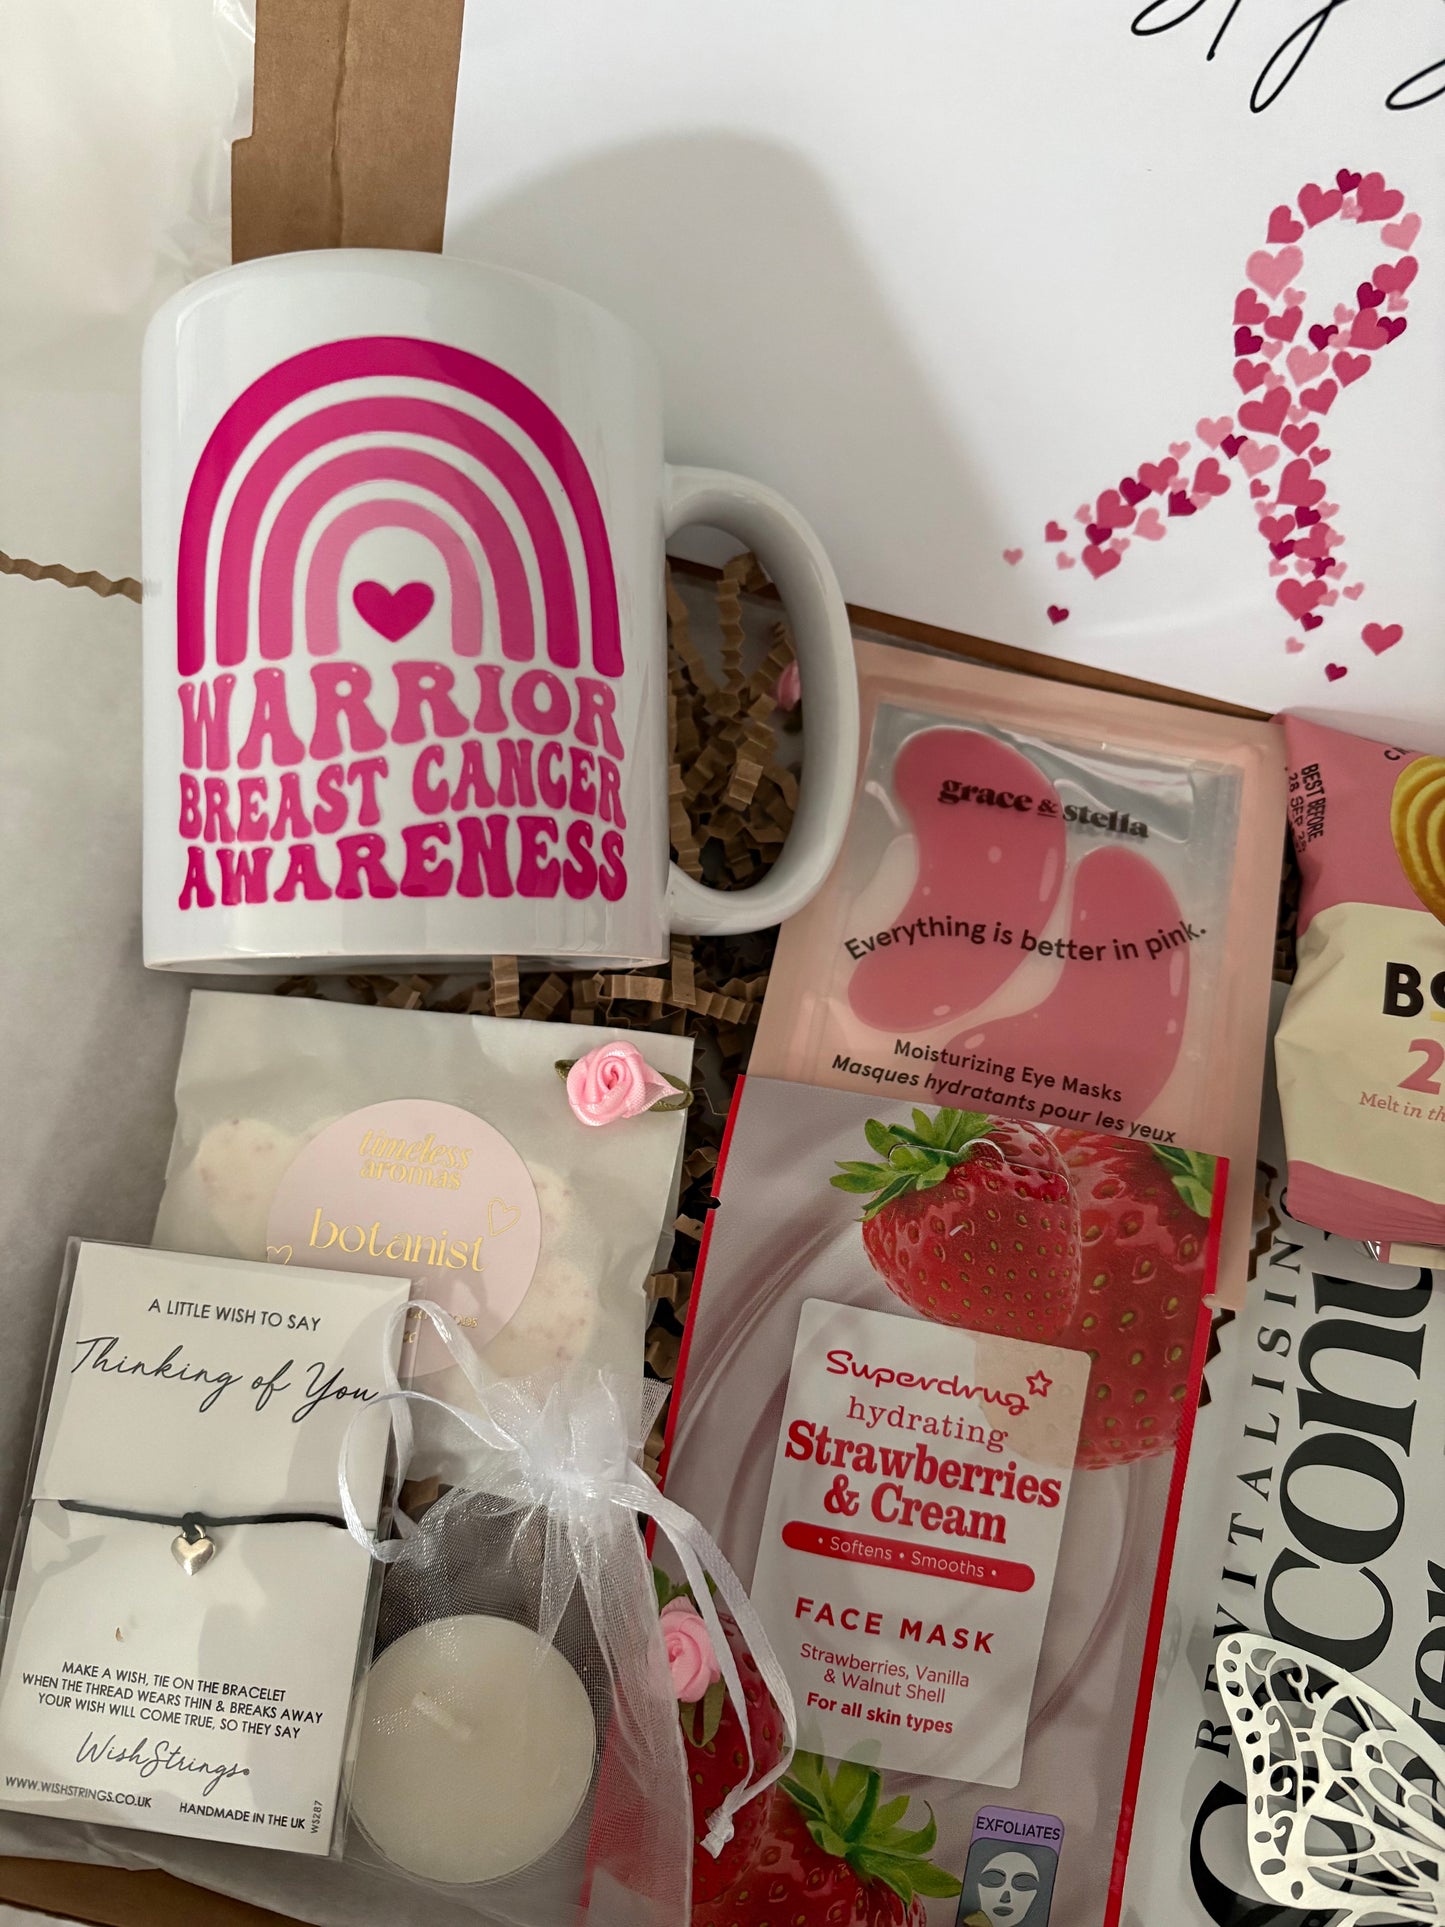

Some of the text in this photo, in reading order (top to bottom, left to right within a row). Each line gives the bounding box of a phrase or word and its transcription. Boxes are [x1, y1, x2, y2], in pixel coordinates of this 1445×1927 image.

[178, 661, 624, 772] WARRIOR
[179, 738, 627, 843] BREAST CANCER
[1301, 763, 1325, 797] BEST
[937, 779, 1150, 839] grace & stella
[178, 814, 628, 911] AWARENESS
[844, 915, 1207, 961] Everything is better in pink.
[893, 1038, 1123, 1103] Moisturizing Eye Masks
[831, 1054, 1177, 1144] Masques hydratants pour les yeux
[1359, 1091, 1400, 1113] Melt
[1403, 1101, 1422, 1119] in
[358, 1128, 473, 1170] timeless
[359, 1157, 463, 1191] aromas
[308, 1207, 487, 1272] botanist
[148, 1298, 321, 1332] A LITTLE WISH TO SAY
[71, 1336, 379, 1423] Thinking of You
[826, 1349, 1030, 1416] Superdrug
[846, 1395, 1009, 1453] hydrating
[784, 1418, 1063, 1508] Strawberries
[823, 1473, 1007, 1545] & Cream
[830, 1535, 985, 1578] Softens Smooths
[794, 1596, 995, 1654] FACE MASK
[61, 1661, 287, 1702] MAKE A WISH, TIE ON THE BRACELET
[800, 1643, 970, 1688] Strawberries, Vanilla
[823, 1668, 946, 1704] & Walnut Shell
[22, 1672, 324, 1724] WHEN THE THREAD WEARS THIN & BREAKS AWAY
[38, 1692, 301, 1739] YOUR WISH WILL COME TRUE, SO THEY SAY
[806, 1691, 954, 1735] For all skin types
[5, 1775, 306, 1830] WWW.WISHSTRINGS.CO.UK HANDMADE IN THE UK
[310, 1800, 324, 1834] WS287
[975, 1815, 1061, 1842] EXFOLIATES
